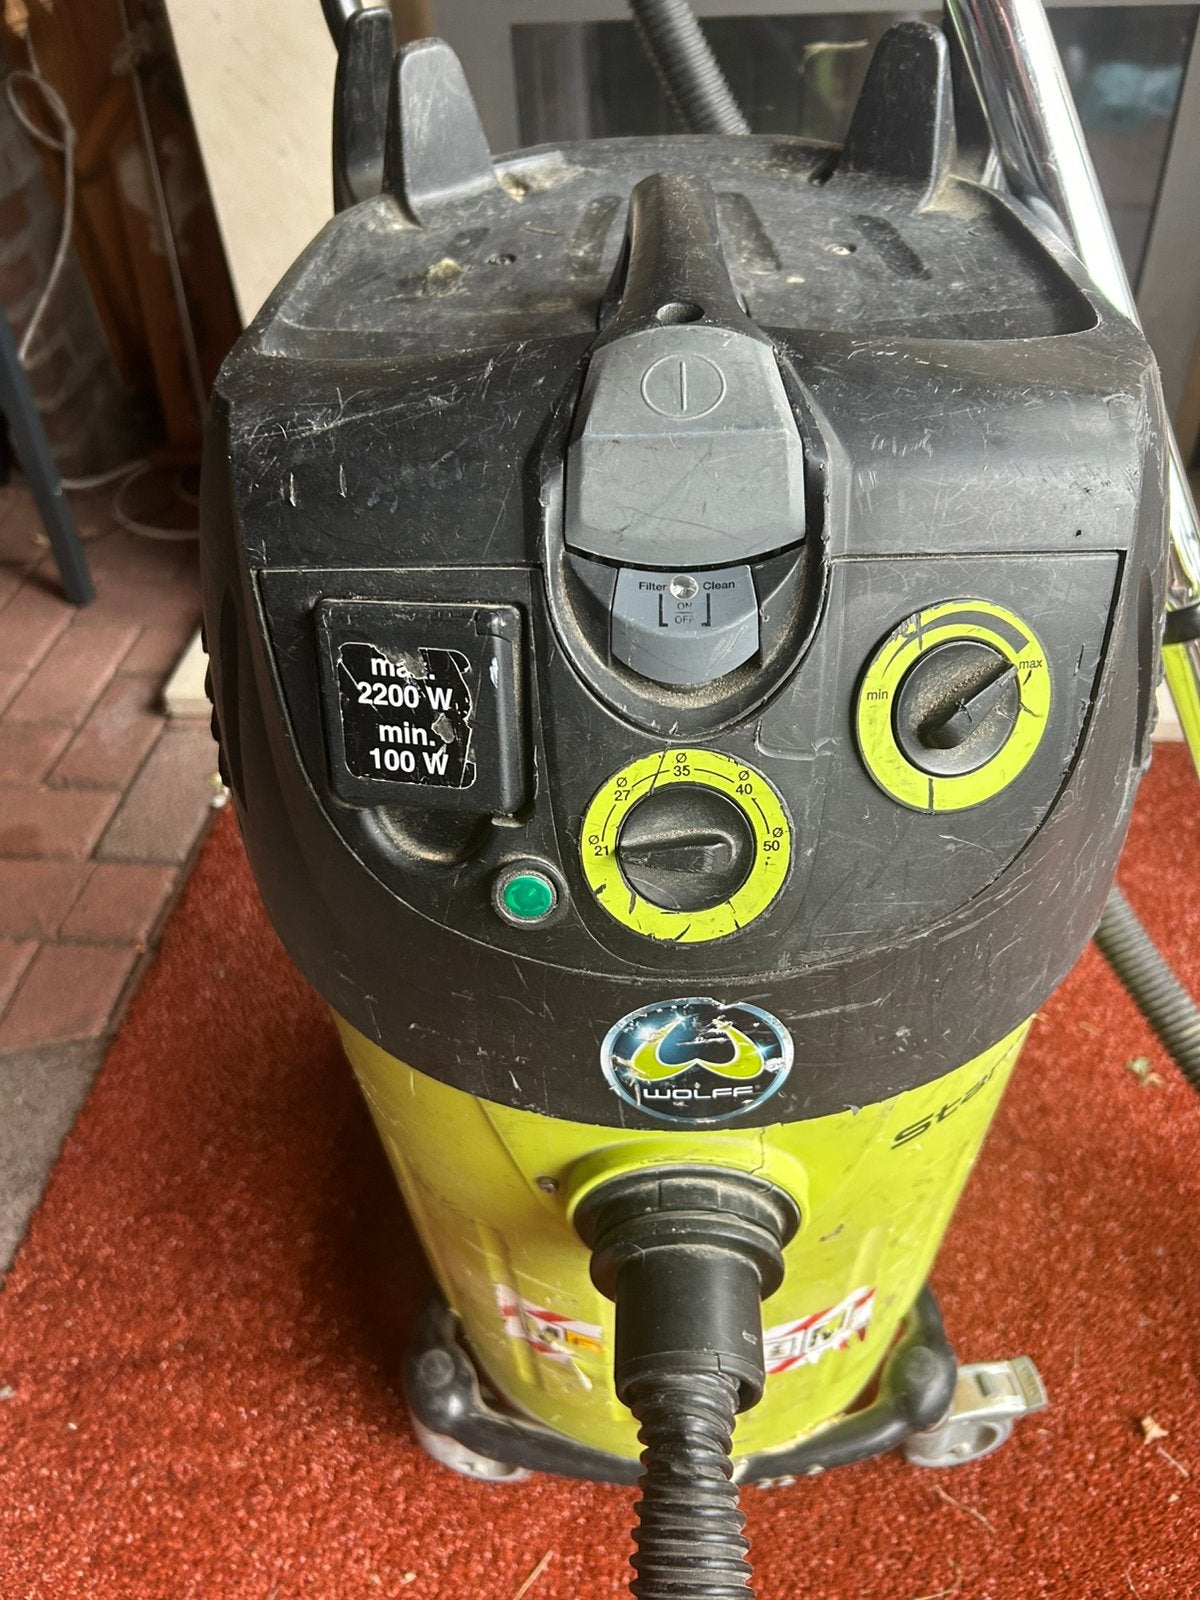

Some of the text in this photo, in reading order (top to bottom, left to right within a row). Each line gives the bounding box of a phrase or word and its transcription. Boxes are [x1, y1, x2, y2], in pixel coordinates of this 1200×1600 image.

[638, 581, 736, 591] Filter Clean
[676, 602, 693, 610] ON
[370, 657, 436, 680] ma.
[1018, 658, 1043, 669] max
[357, 681, 453, 711] 2200 W
[866, 689, 889, 701] min
[378, 721, 436, 747] min.
[369, 747, 449, 776] 100 W
[673, 766, 691, 777] 35
[735, 784, 753, 795] 40
[614, 789, 631, 802] 27
[594, 845, 609, 856] 21
[763, 841, 780, 852] 50
[643, 1086, 753, 1100] WOLFF
